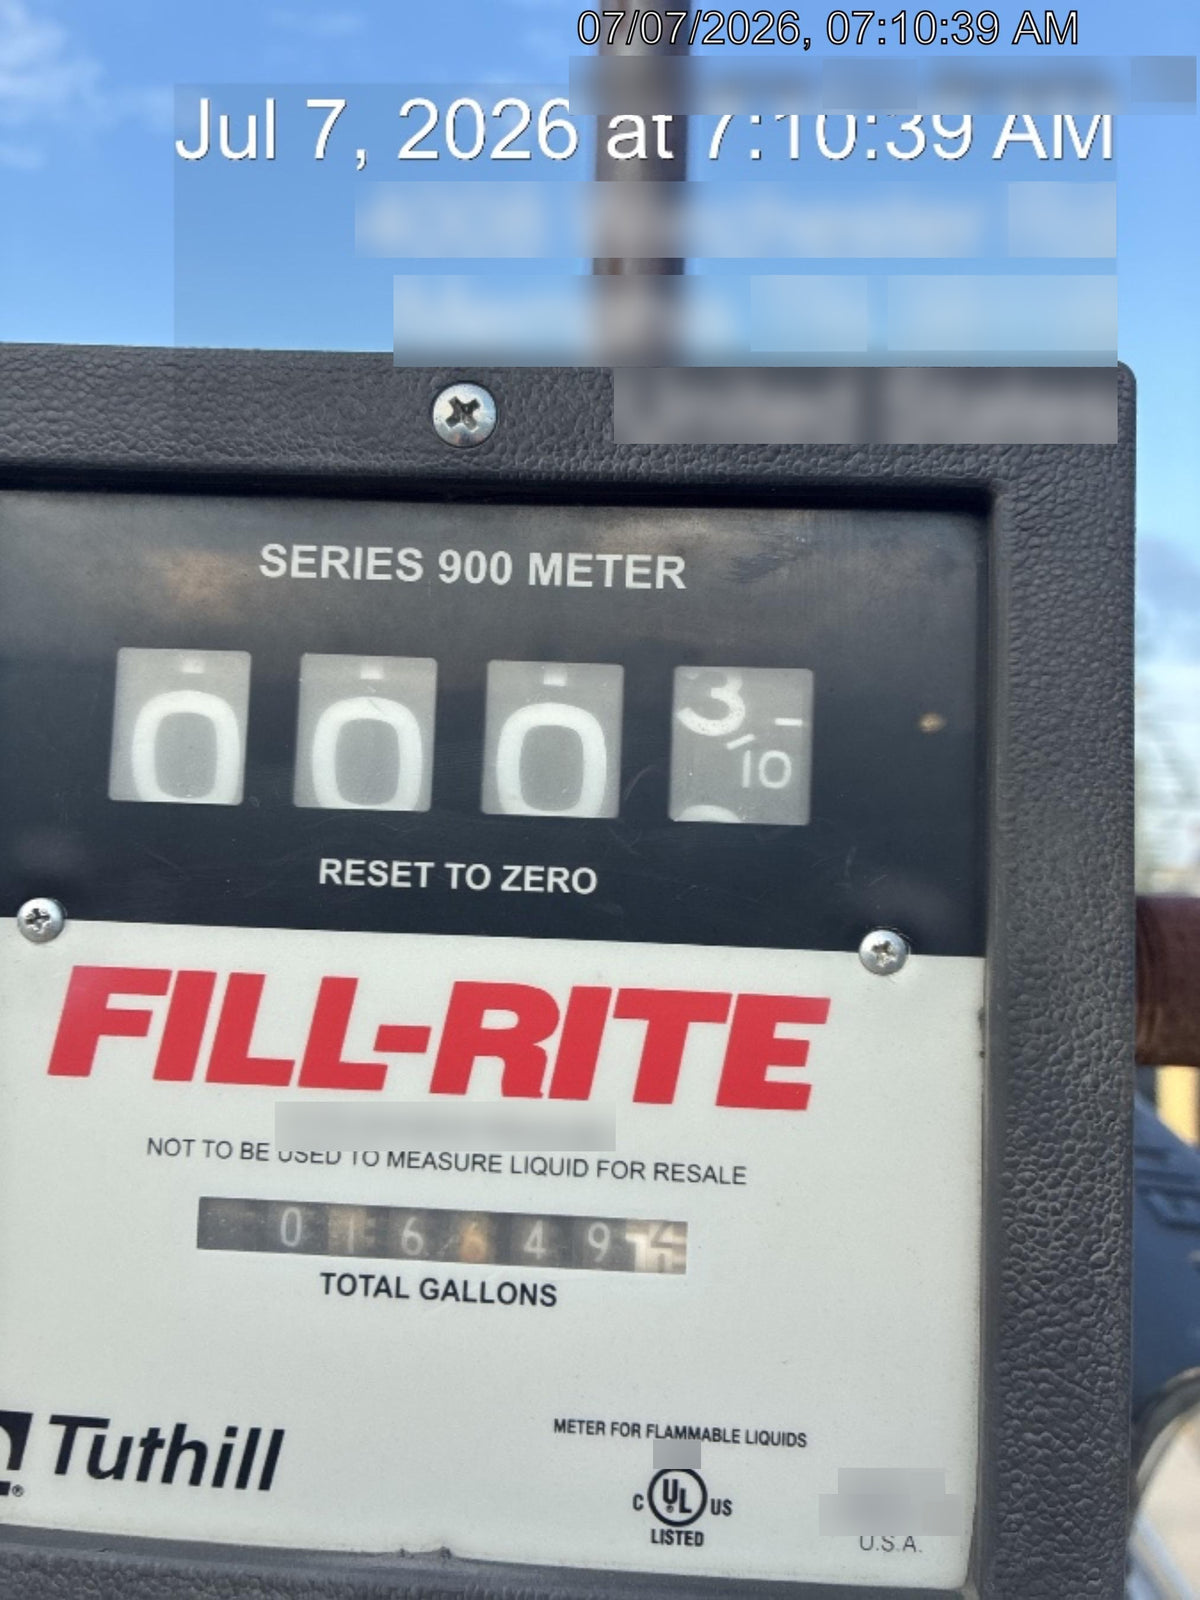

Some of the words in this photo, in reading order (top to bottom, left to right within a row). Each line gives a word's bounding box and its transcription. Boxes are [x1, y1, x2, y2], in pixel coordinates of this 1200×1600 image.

[259, 543, 424, 583] SERIES
[438, 549, 513, 585] 900
[528, 552, 687, 590] METER
[319, 858, 435, 888] RESET
[445, 862, 491, 891] TO
[500, 865, 598, 895] ZERO
[47, 965, 831, 1111] FILL-RITE
[147, 1137, 196, 1158] NOT
[203, 1139, 233, 1160] TO
[240, 1142, 270, 1162] BE
[387, 1151, 502, 1174] MEASURE
[510, 1155, 589, 1179] LIQUID
[597, 1160, 646, 1182] FOR
[653, 1163, 747, 1186] RESALE
[320, 1273, 410, 1299] TOTAL
[418, 1278, 558, 1308] GALLONS
[554, 1418, 606, 1436] METER
[611, 1421, 641, 1439] FOR
[646, 1423, 741, 1445] FLAMMABLE
[745, 1430, 808, 1448] LIQUIDS
[49, 1414, 285, 1492] Tuthill
[711, 1498, 733, 1517] US
[651, 1528, 705, 1548] LISTED
